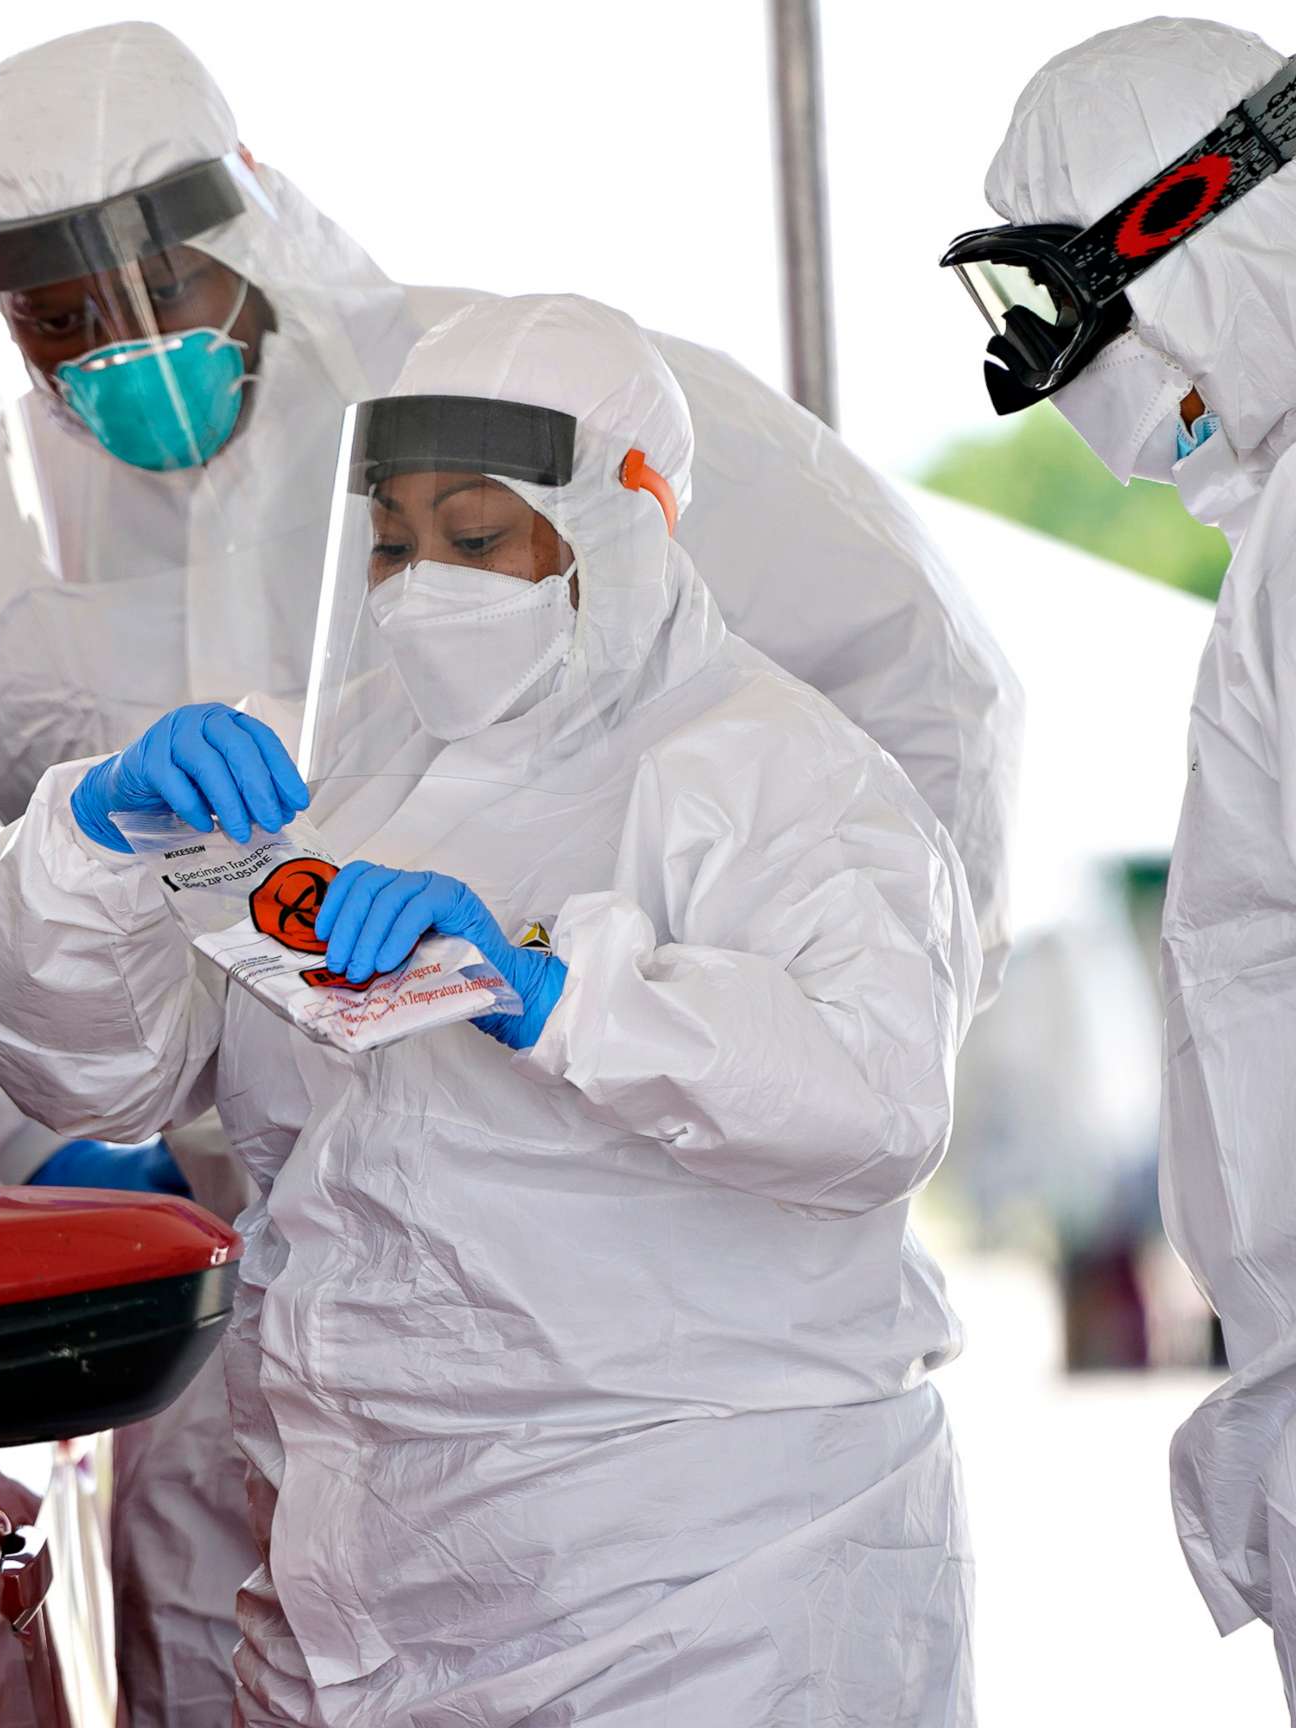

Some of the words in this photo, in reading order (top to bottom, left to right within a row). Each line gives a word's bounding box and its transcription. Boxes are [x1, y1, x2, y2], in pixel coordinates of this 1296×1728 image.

[174, 864, 228, 883] Specimen
[206, 875, 222, 886] ZIP
[224, 854, 273, 882] CLOSURE
[408, 983, 464, 1005] Temperatura
[464, 974, 504, 992] Ambiente
